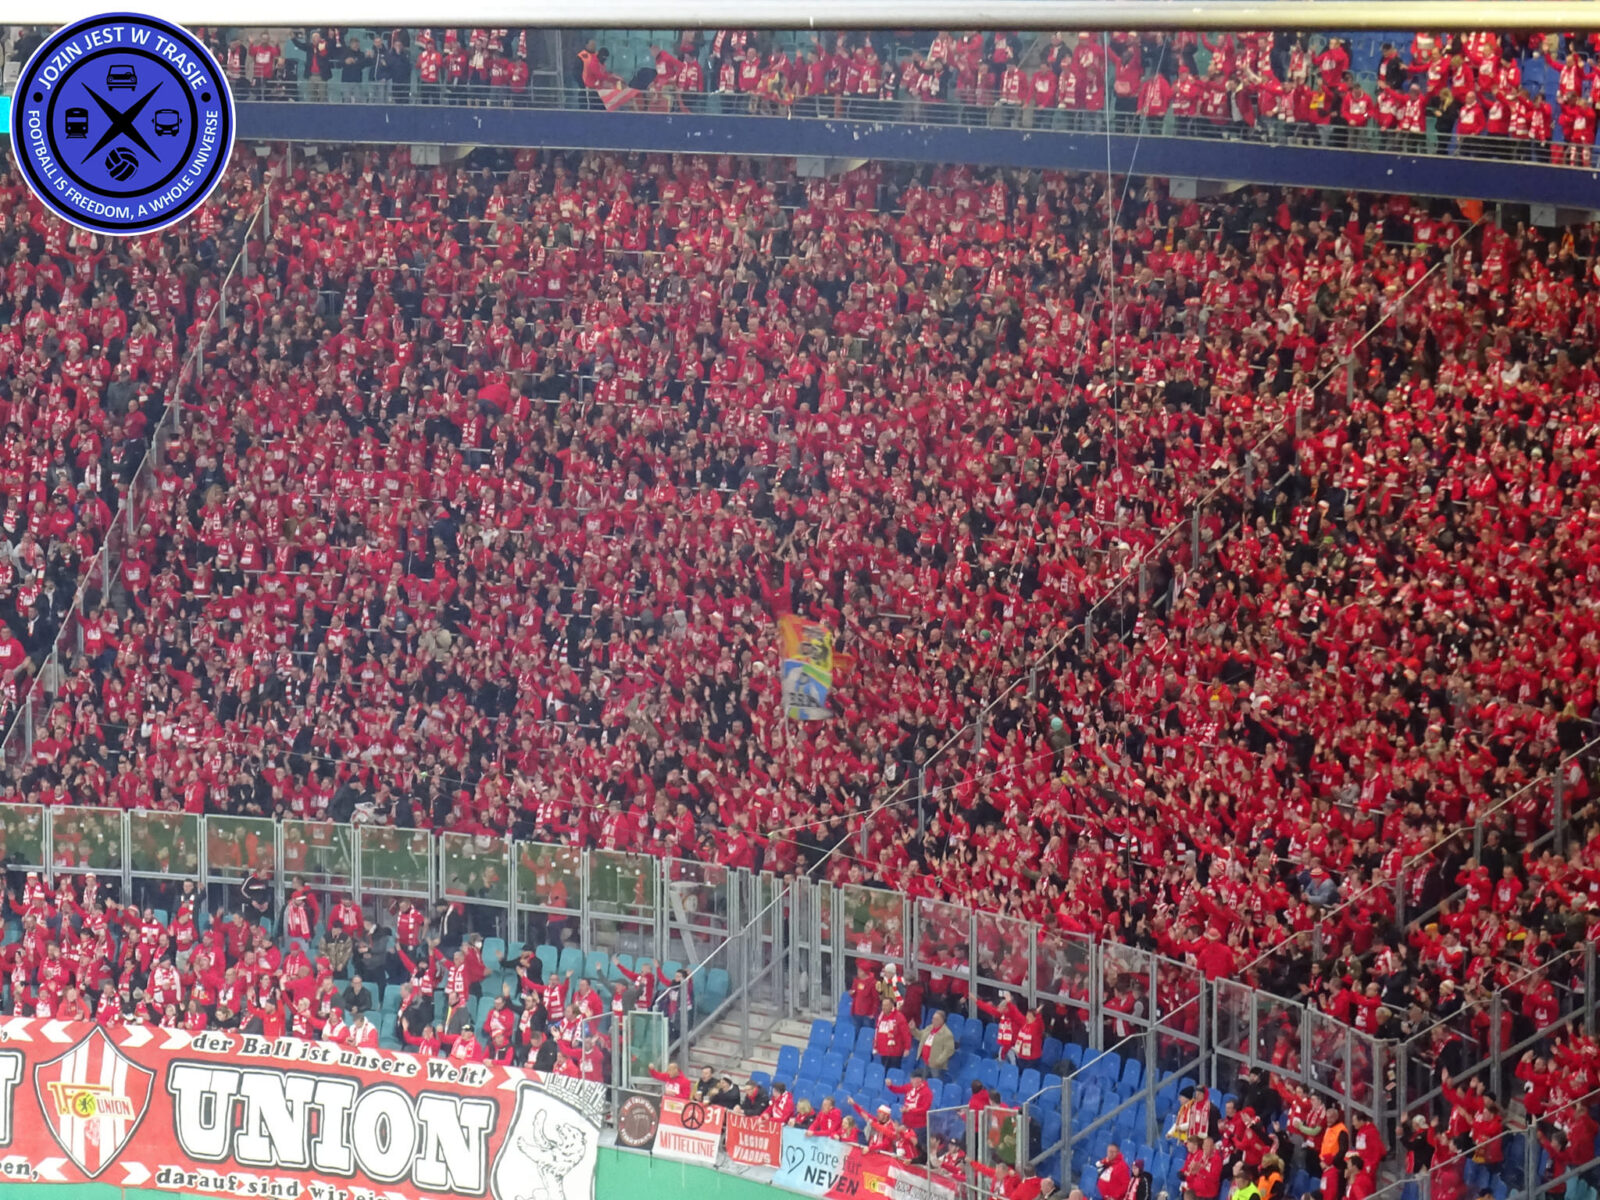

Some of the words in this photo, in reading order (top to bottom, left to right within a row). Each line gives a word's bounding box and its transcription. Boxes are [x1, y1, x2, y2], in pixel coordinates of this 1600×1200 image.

[193, 1034, 234, 1051] der
[242, 1038, 293, 1056] Ball
[300, 1043, 331, 1062] ist
[340, 1050, 418, 1075] unsere
[427, 1062, 487, 1085] Welt!
[96, 1097, 132, 1117] UNION
[704, 1106, 722, 1126] 31
[169, 1062, 496, 1194] UNION
[810, 1146, 839, 1168] Tore
[157, 1168, 238, 1191] darauf
[248, 1178, 298, 1197] sind
[310, 1187, 347, 1200] wir
[804, 1165, 861, 1196] NEVEN
